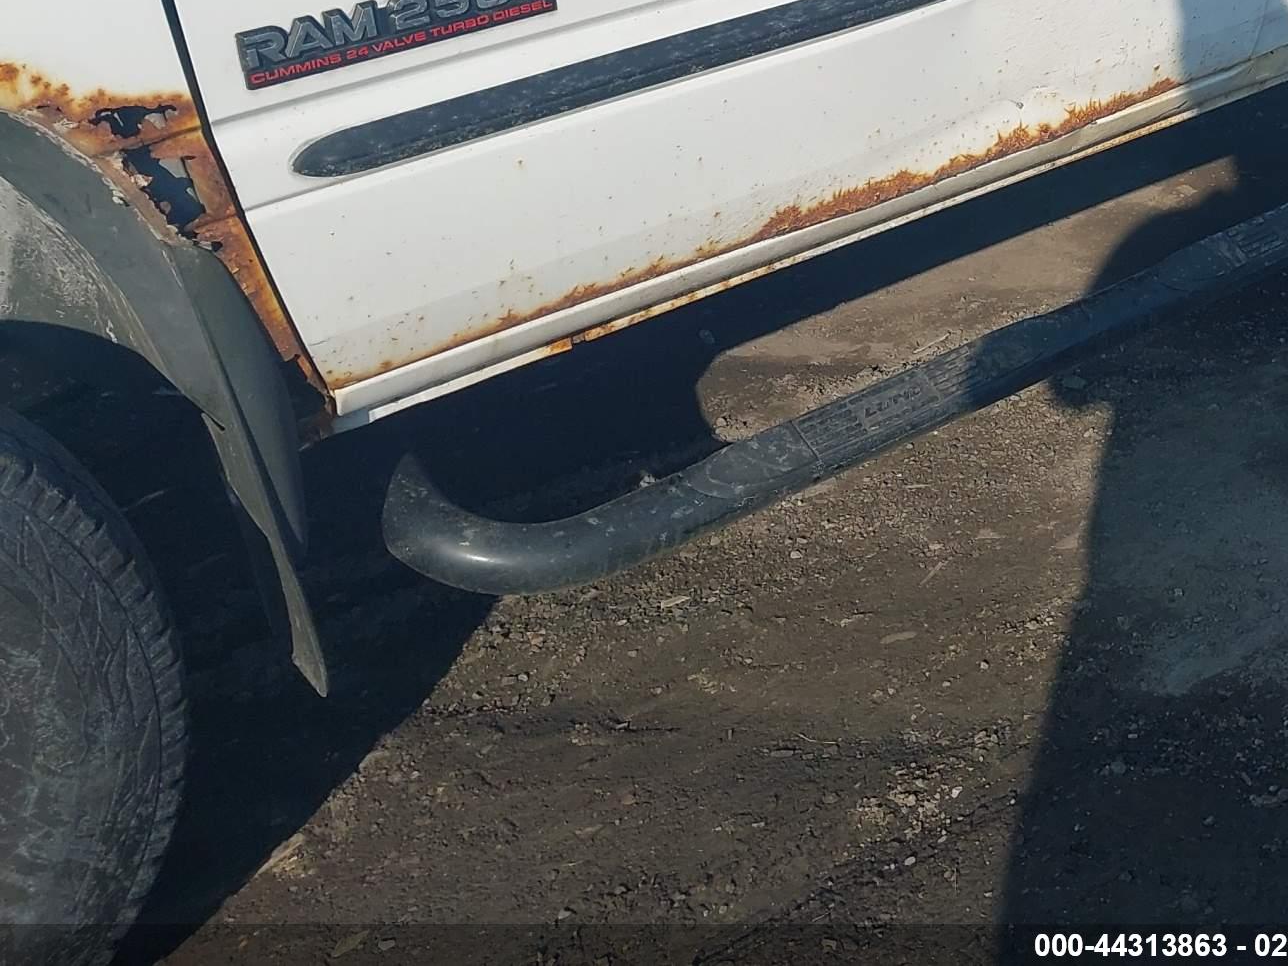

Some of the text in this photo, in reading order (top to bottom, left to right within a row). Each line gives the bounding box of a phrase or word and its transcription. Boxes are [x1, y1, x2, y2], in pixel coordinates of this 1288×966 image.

[241, 0, 377, 68] RAM
[250, 0, 553, 84] CUMMINS 24 VALVE TURBO DIESEL
